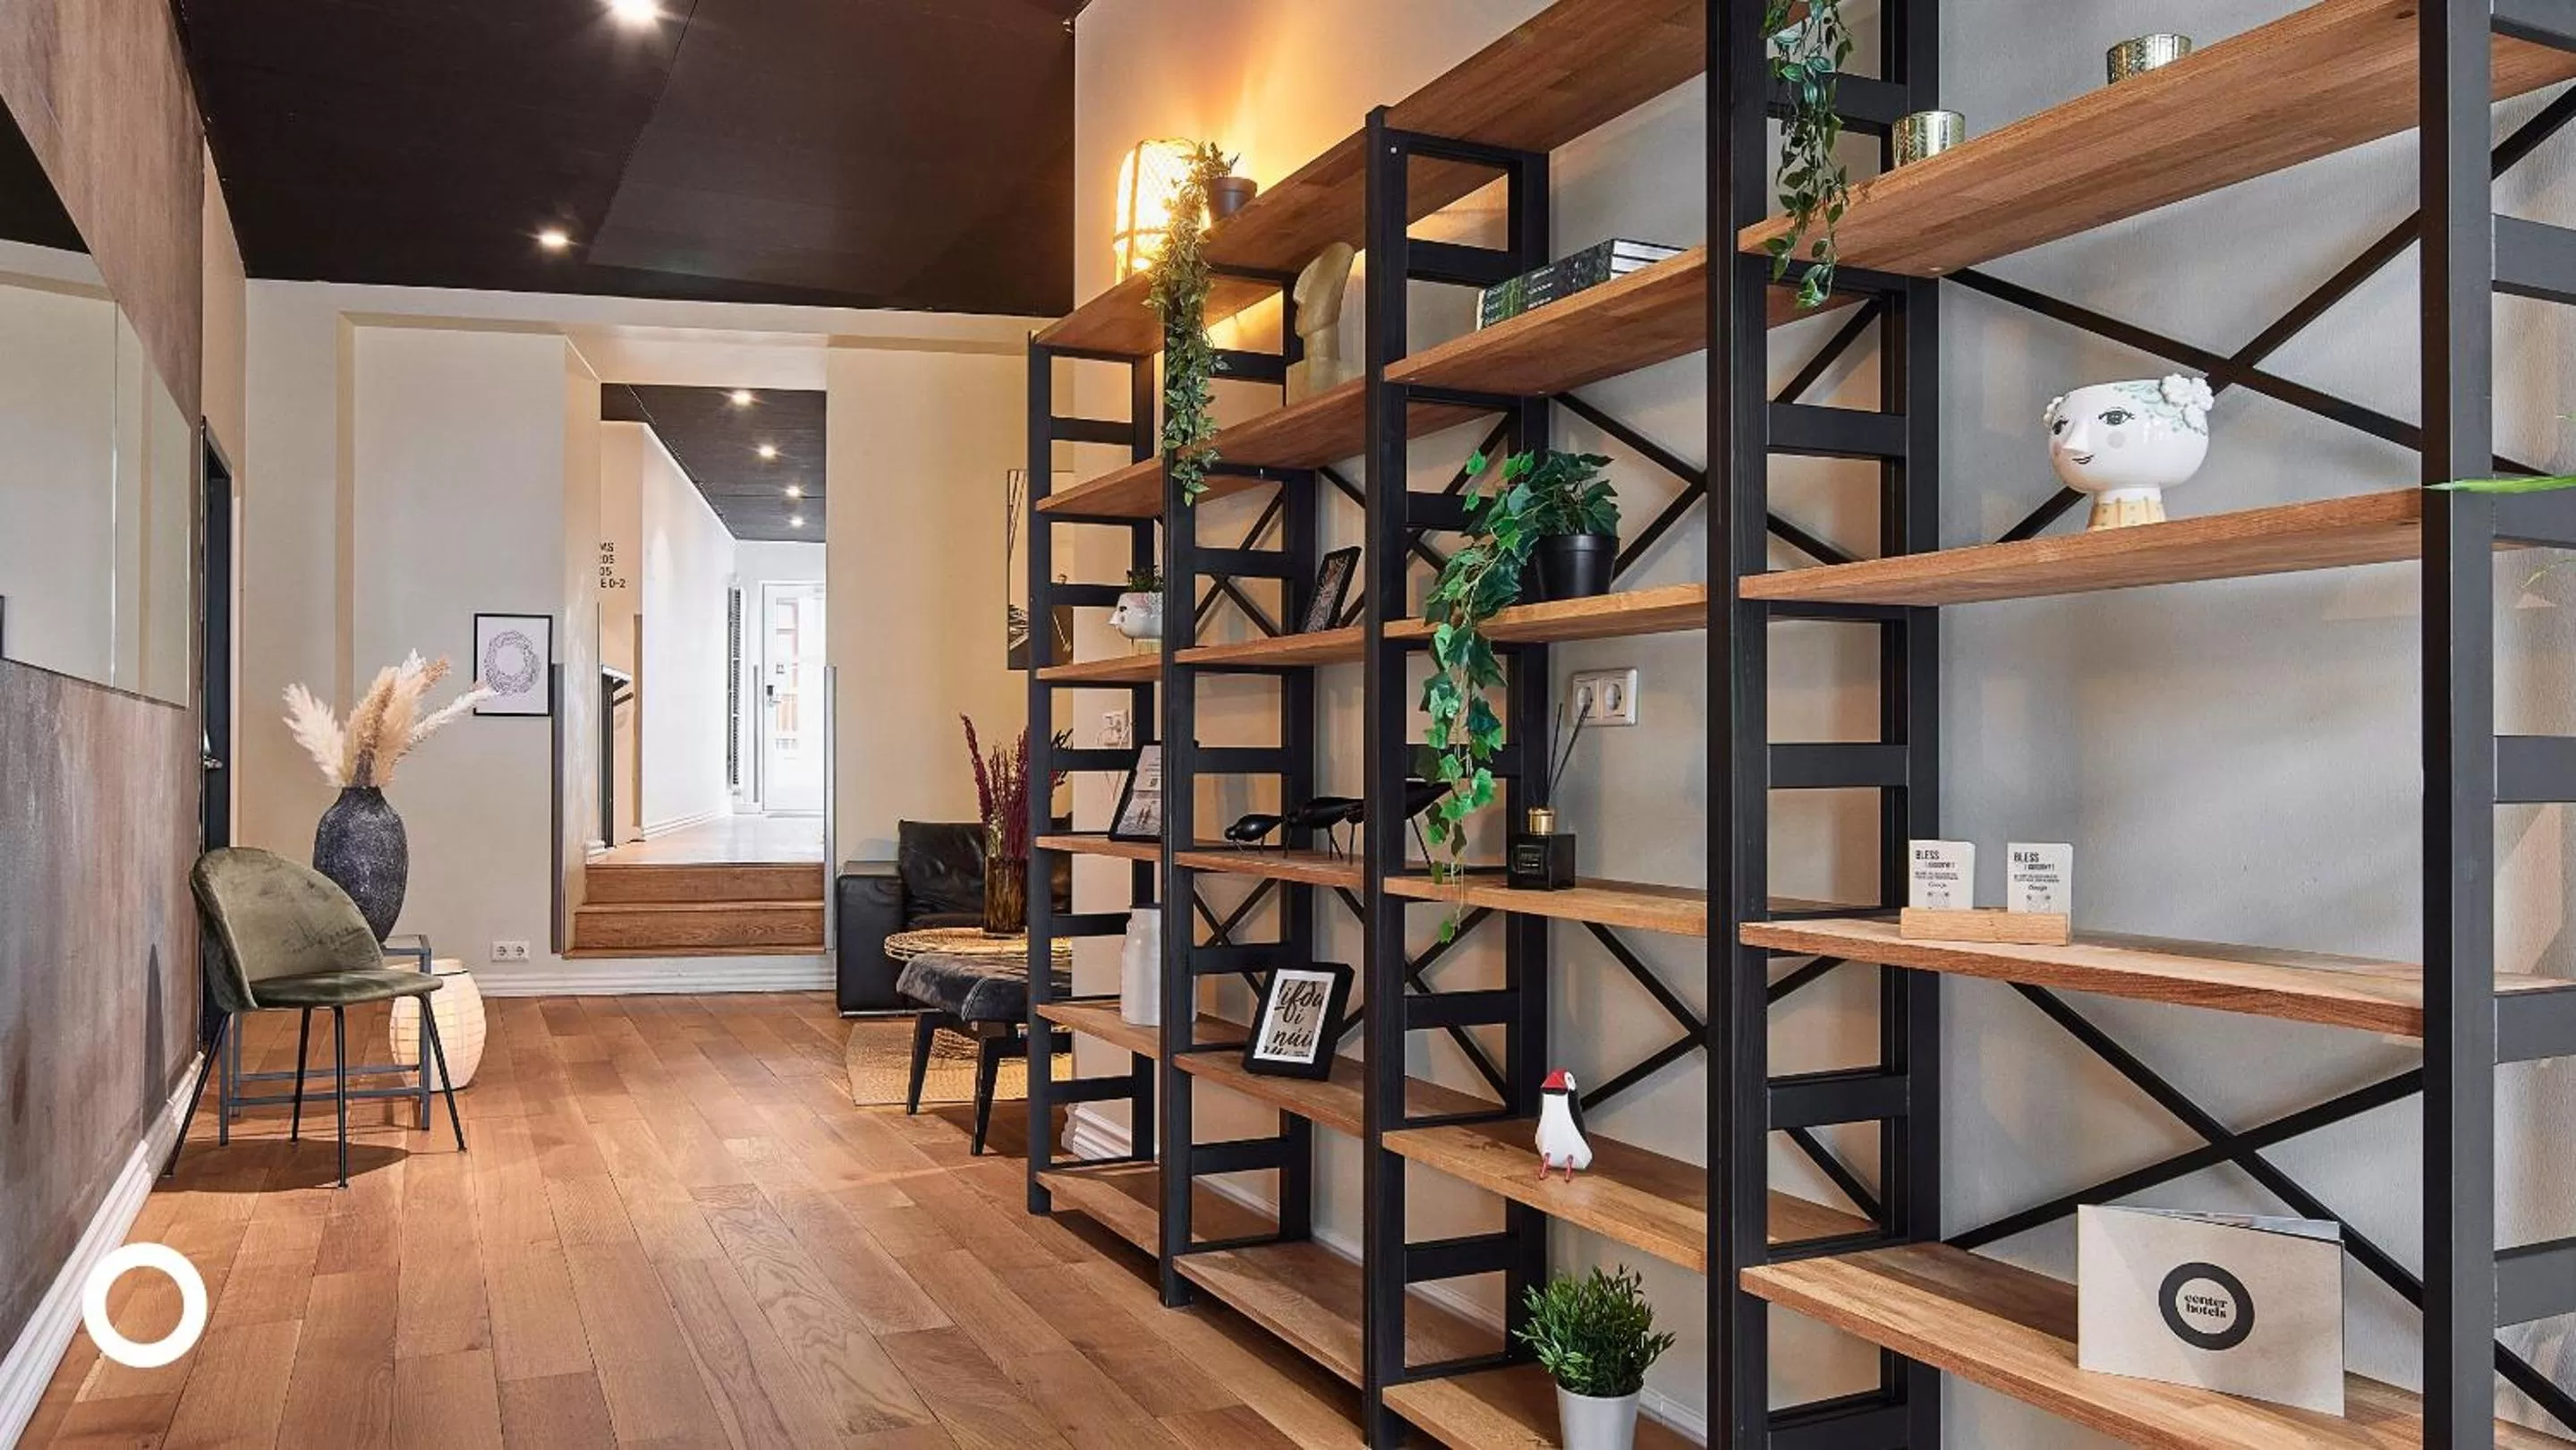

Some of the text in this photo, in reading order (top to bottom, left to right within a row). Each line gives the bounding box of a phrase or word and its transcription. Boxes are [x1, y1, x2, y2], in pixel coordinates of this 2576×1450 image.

[1915, 849, 1940, 860] BLESS
[2013, 851, 2040, 863] BLESS
[2184, 1294, 2228, 1308] center
[2185, 1303, 2227, 1318] hotels
